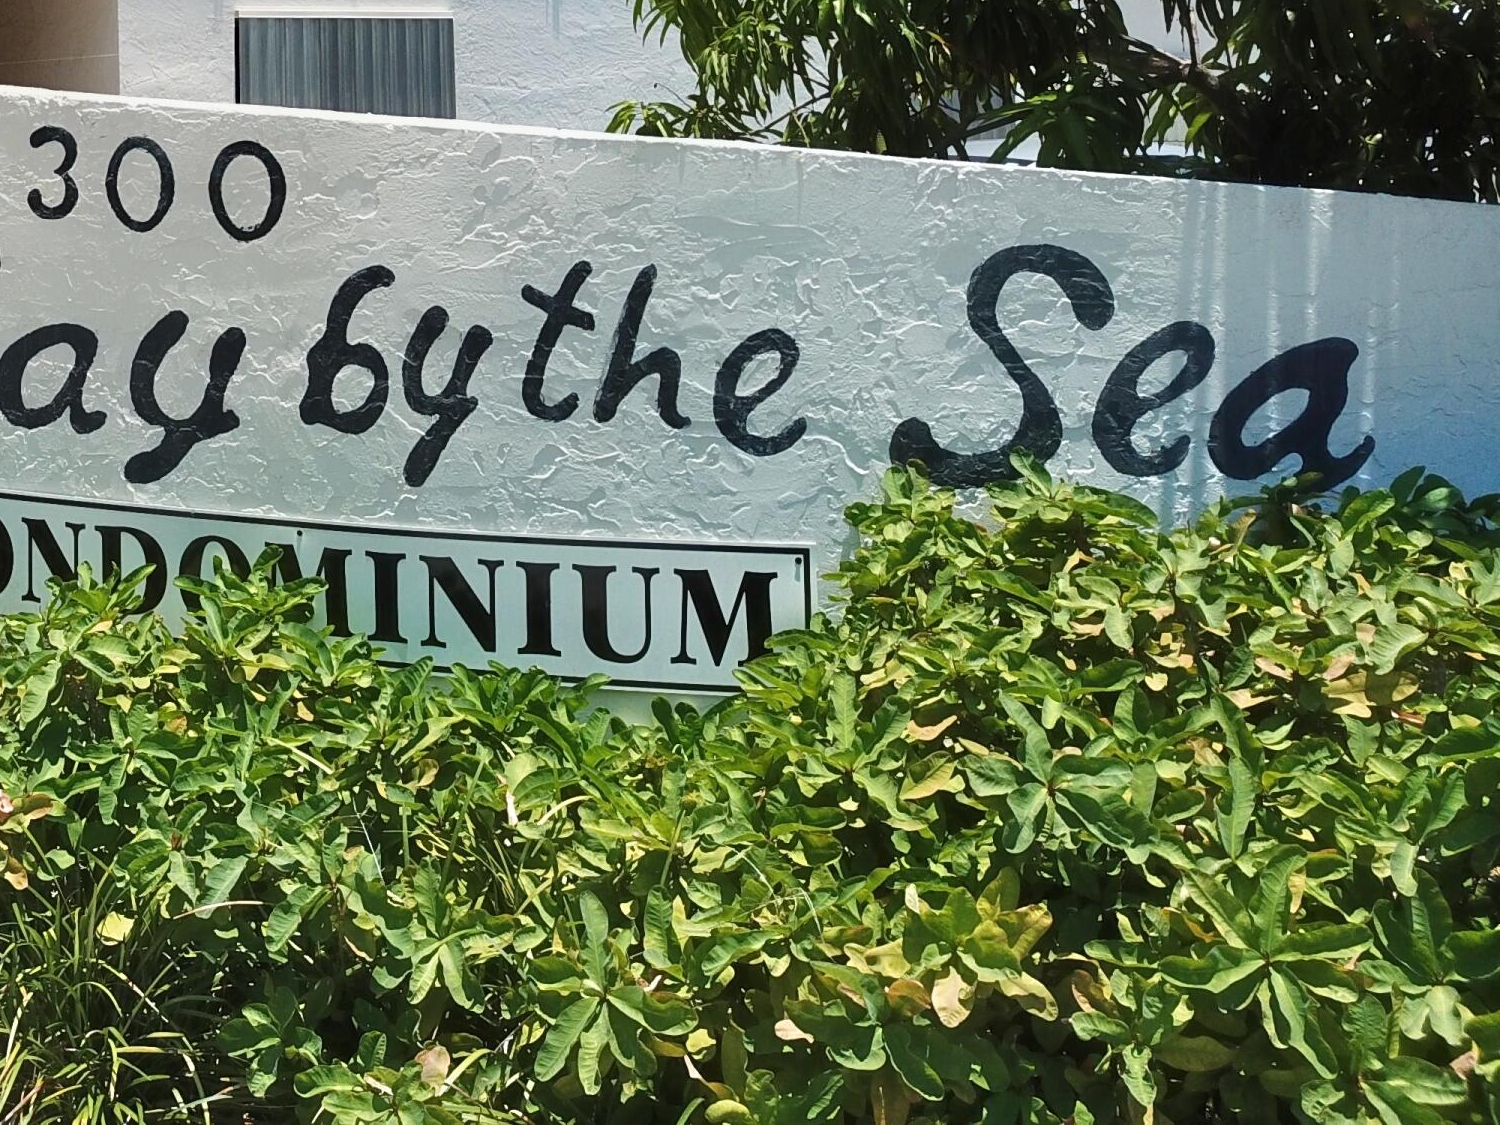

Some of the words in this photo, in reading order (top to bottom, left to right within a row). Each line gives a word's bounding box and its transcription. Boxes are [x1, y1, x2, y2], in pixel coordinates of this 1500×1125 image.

[26, 125, 287, 244] 300
[298, 264, 494, 488] by
[521, 260, 809, 457] the
[888, 243, 1376, 493] Sea
